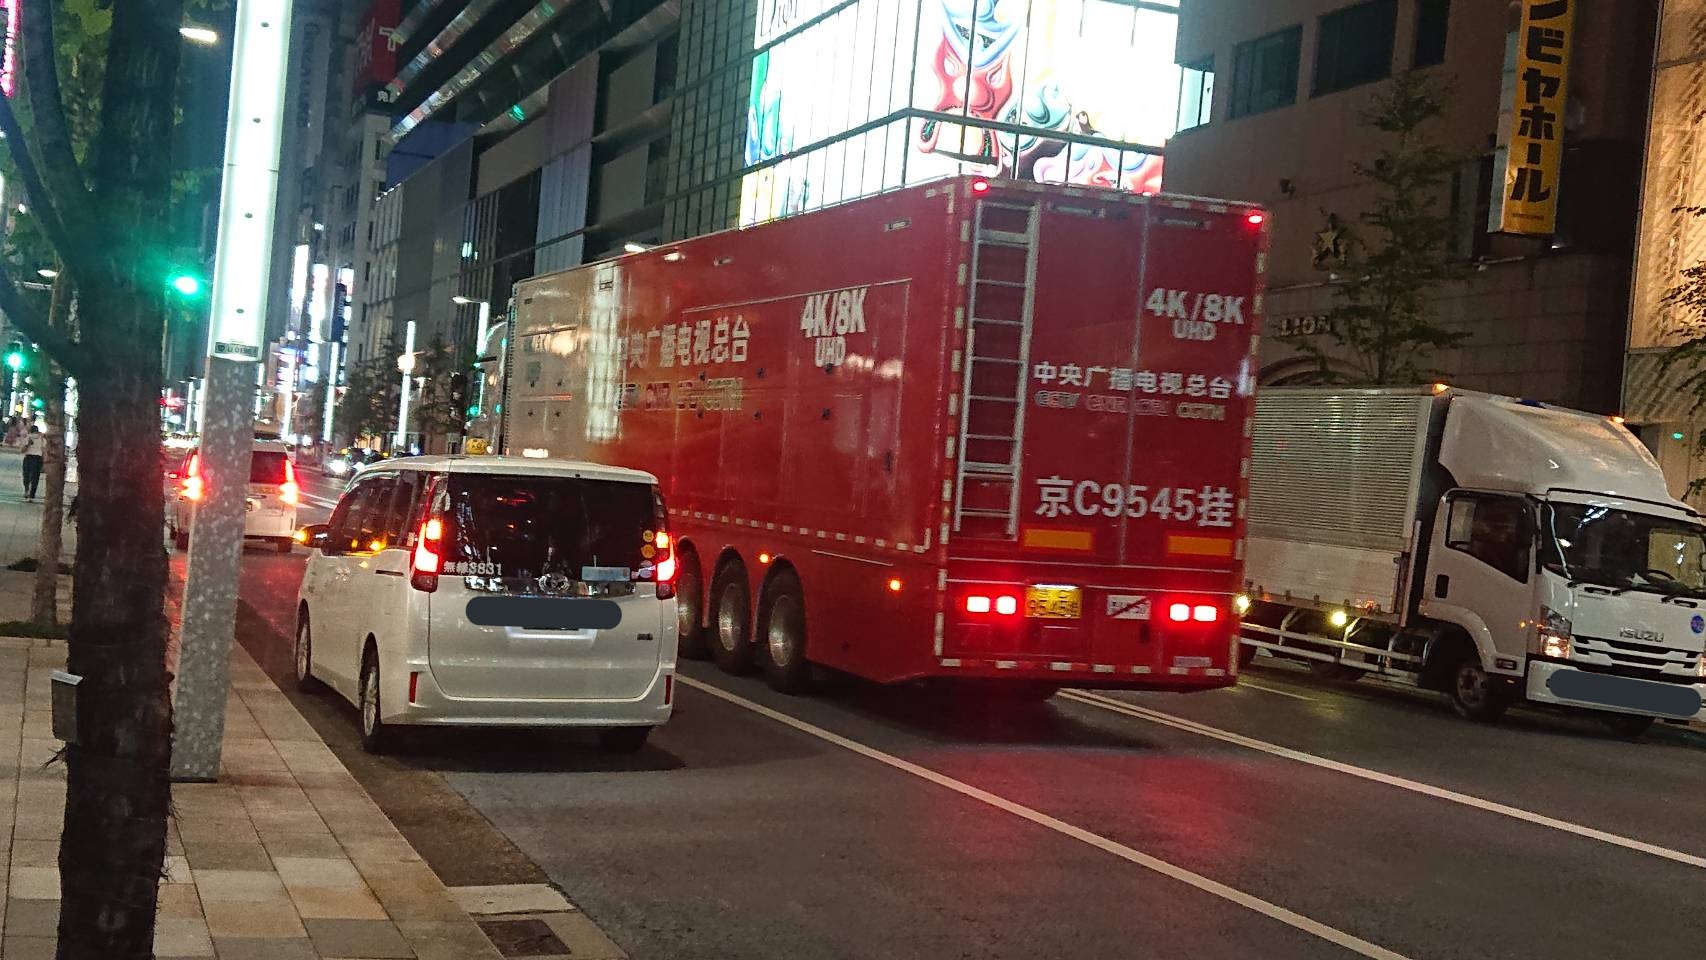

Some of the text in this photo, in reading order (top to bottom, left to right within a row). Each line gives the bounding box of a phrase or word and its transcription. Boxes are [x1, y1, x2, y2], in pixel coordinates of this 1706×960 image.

[800, 287, 867, 338] 4K/8K
[1171, 319, 1217, 341] UHD
[815, 336, 847, 368] UHD
[1033, 361, 1233, 399] 中央广播电视总台
[1035, 475, 1234, 527] 京C9545挂
[1620, 627, 1664, 643] ISUZU
